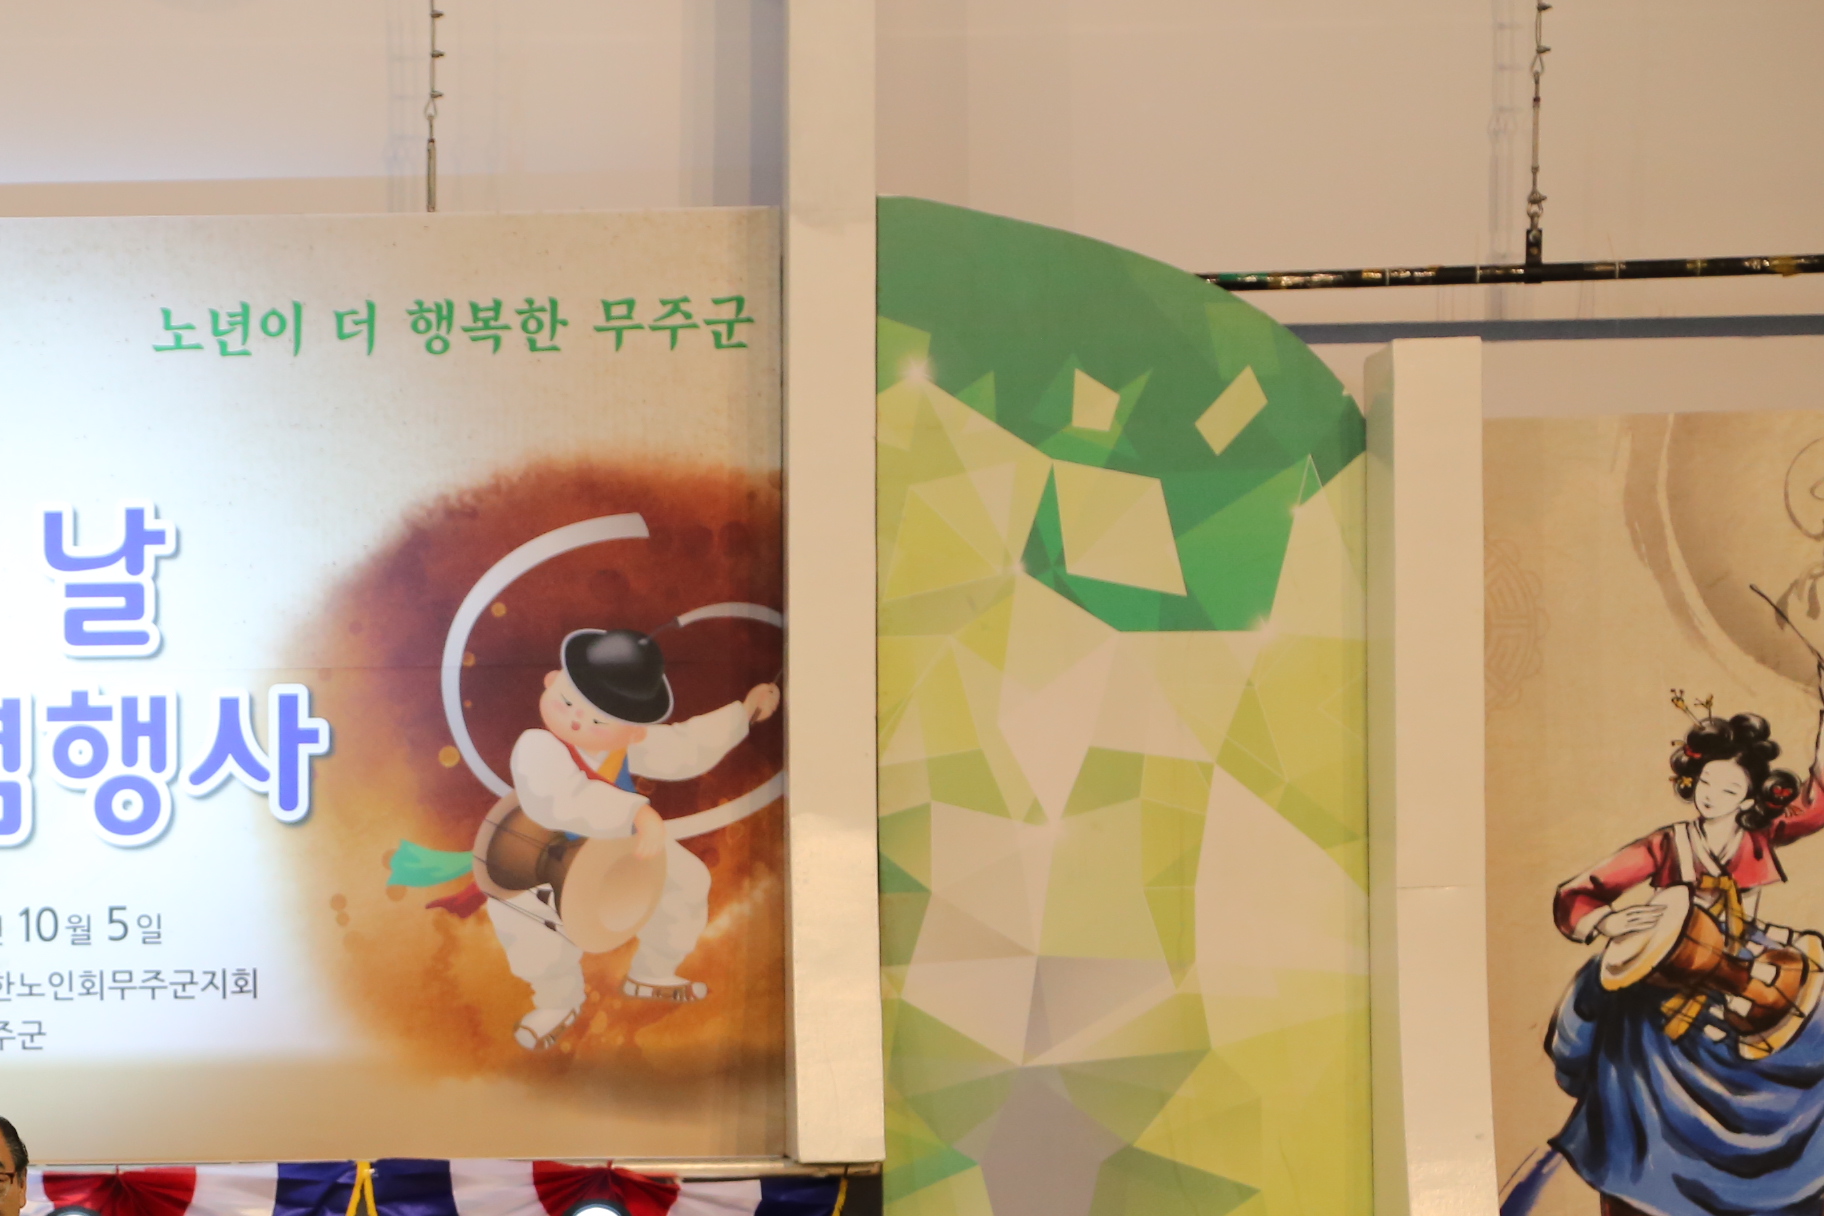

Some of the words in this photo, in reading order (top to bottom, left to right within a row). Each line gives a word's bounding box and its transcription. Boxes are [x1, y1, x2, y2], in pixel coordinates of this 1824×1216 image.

[151, 298, 303, 358] 노년이
[332, 299, 377, 357] 더
[405, 295, 569, 355] 행복한
[592, 294, 756, 352] 무주군
[42, 506, 168, 649] 날
[18, 906, 93, 946] 10월
